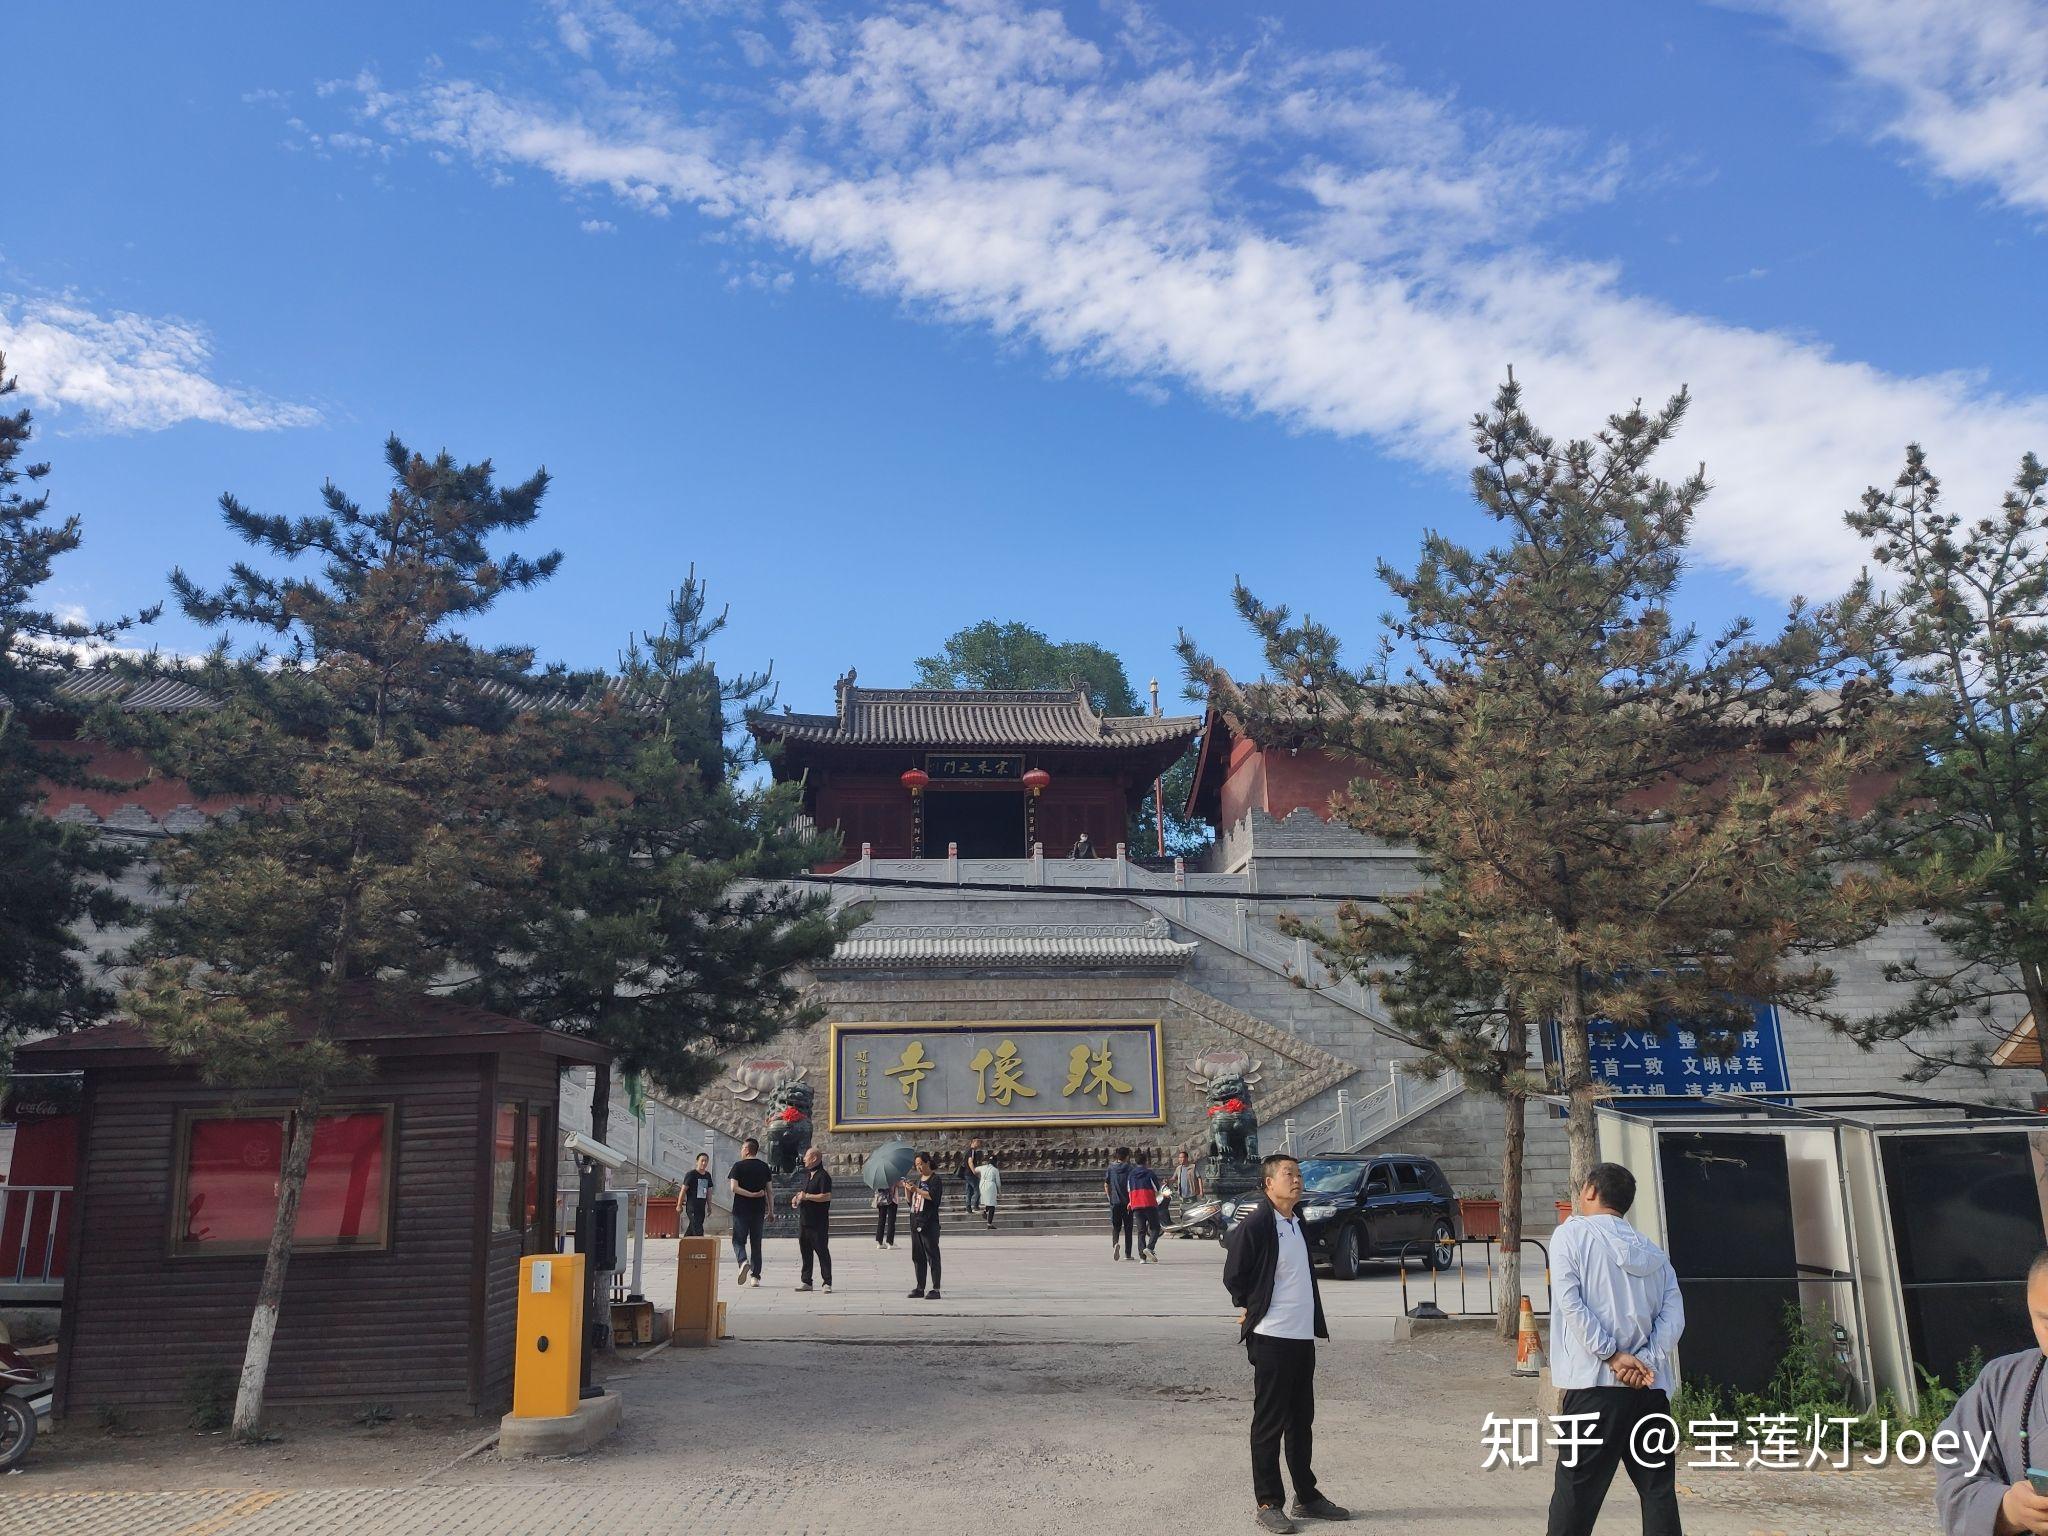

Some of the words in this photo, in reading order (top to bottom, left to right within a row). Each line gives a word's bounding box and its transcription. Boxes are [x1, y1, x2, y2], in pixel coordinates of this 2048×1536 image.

[1677, 1029, 1760, 1049] 整序
[1682, 1056, 1764, 1076] 文明停车
